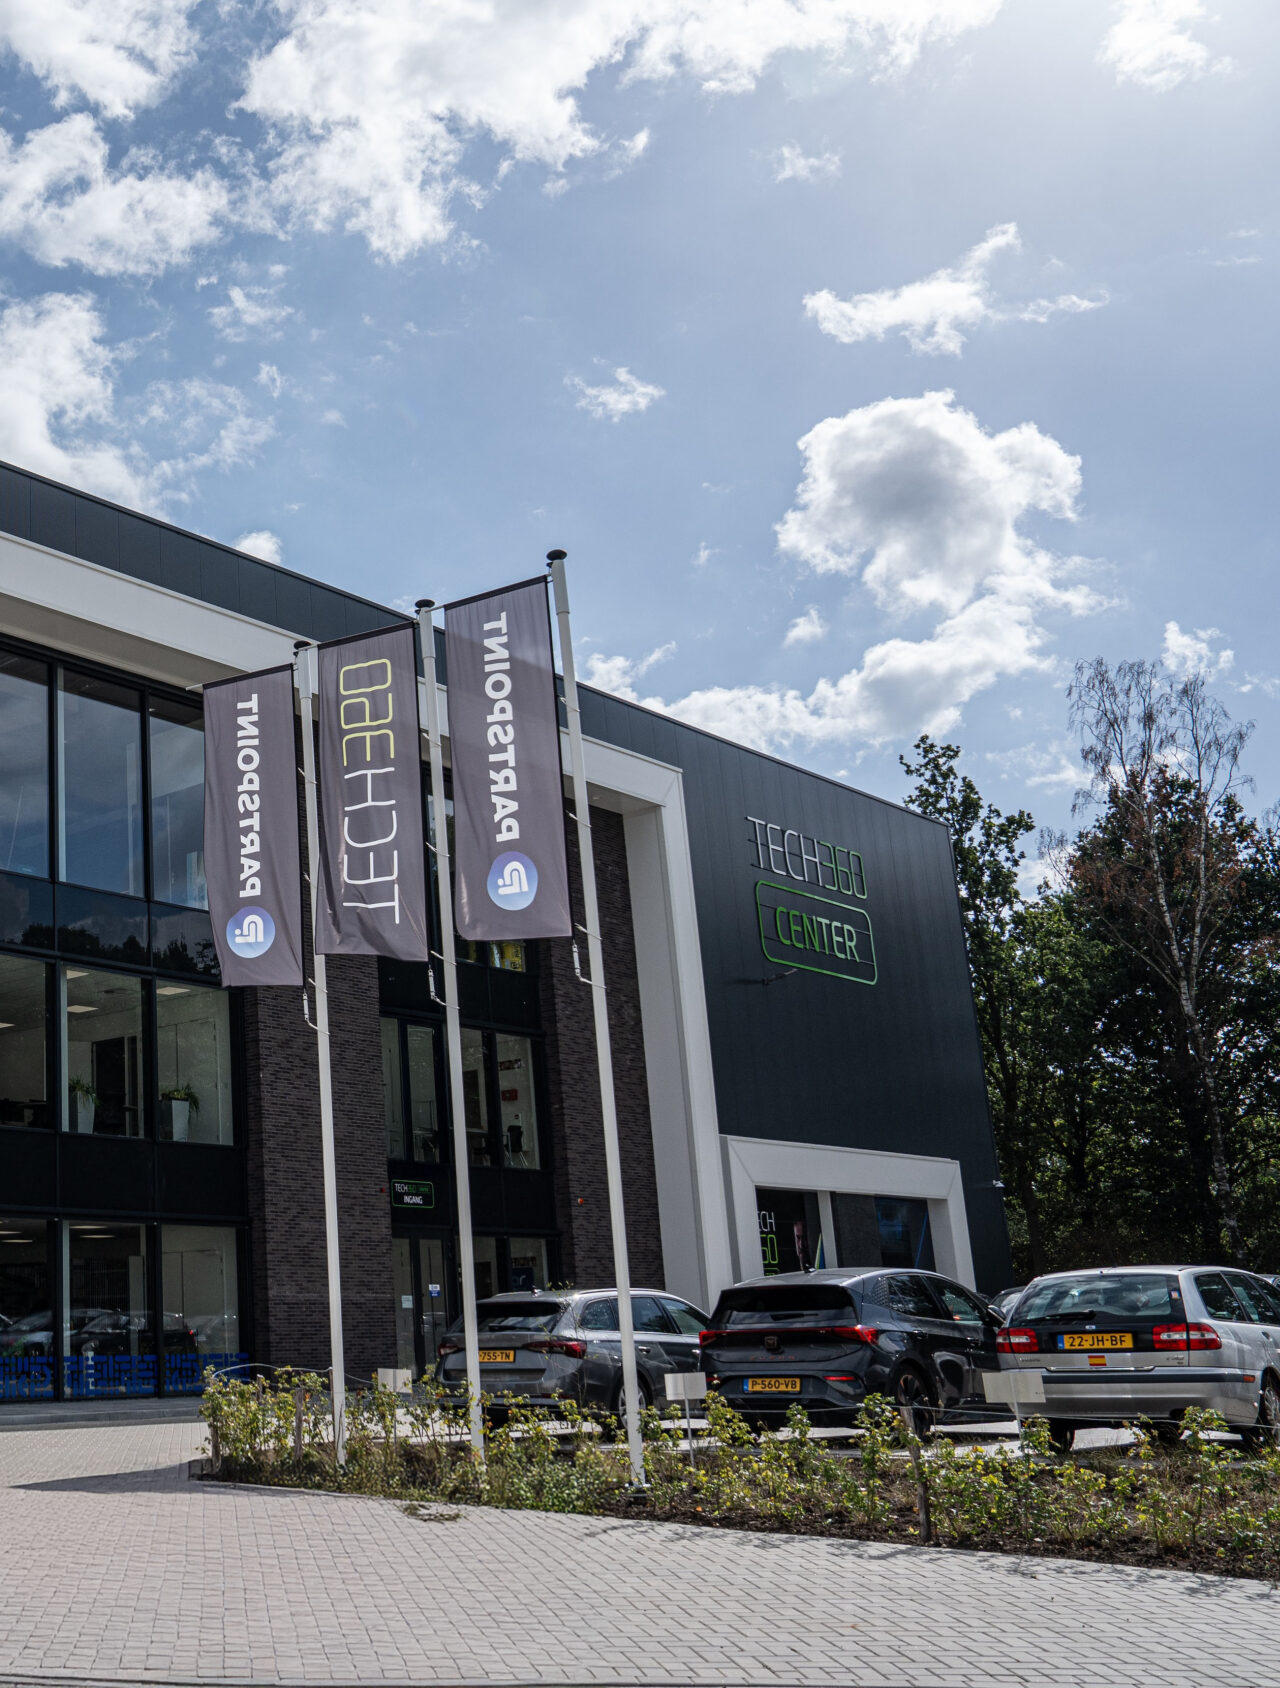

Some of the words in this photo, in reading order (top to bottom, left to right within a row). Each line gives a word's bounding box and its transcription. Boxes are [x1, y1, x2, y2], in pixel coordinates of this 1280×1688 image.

[746, 816, 868, 899] TECH360
[776, 906, 860, 962] CENTER
[403, 1195, 423, 1204] INGANG
[760, 1234, 778, 1264] 60
[1069, 1335, 1127, 1348] 22-JH-BF
[479, 1350, 511, 1361] -755-TN
[751, 1380, 797, 1389] P-560-VB
